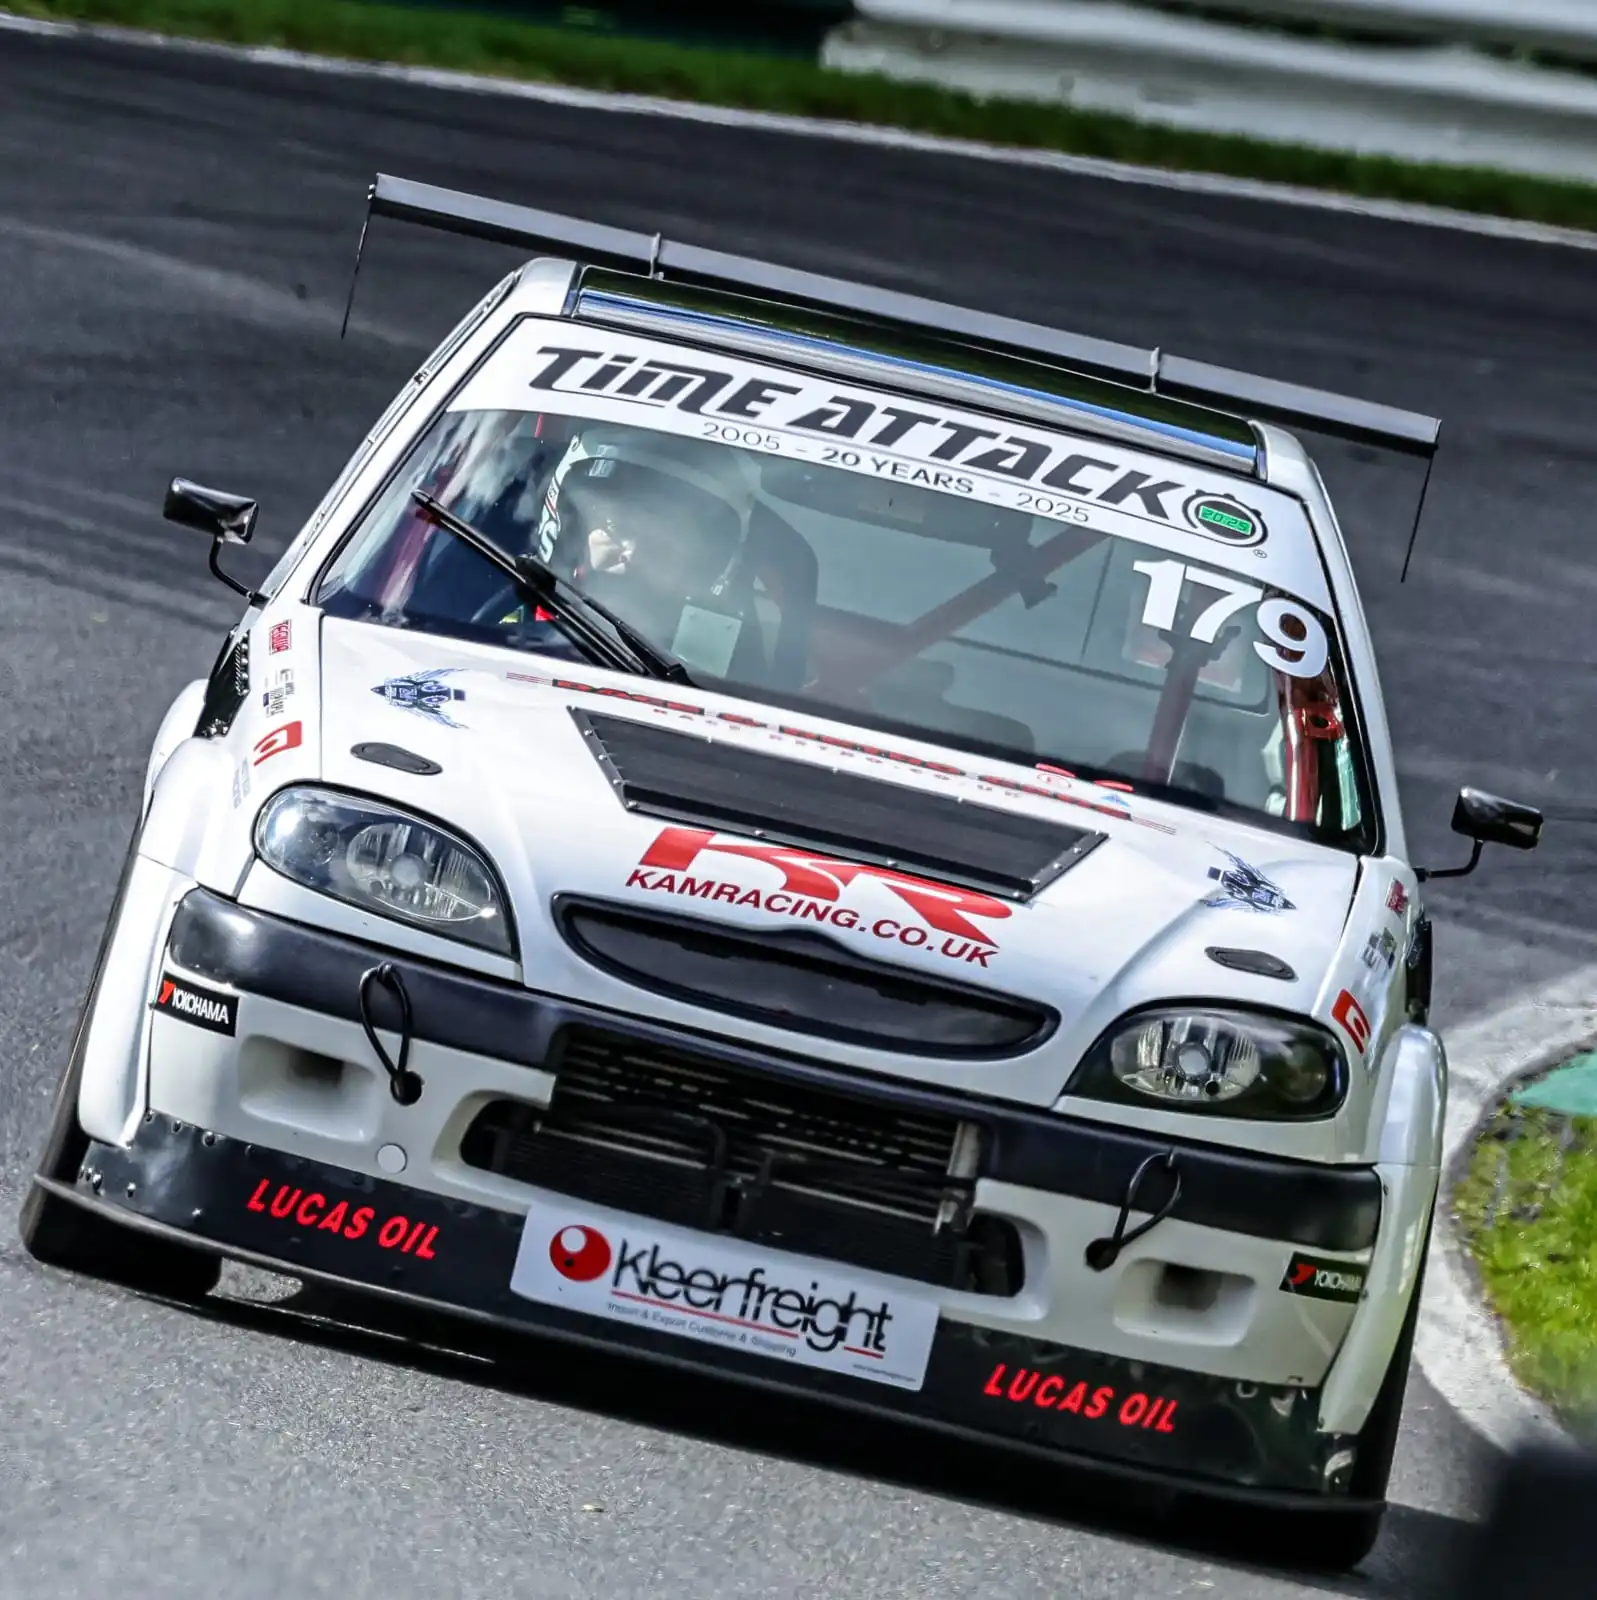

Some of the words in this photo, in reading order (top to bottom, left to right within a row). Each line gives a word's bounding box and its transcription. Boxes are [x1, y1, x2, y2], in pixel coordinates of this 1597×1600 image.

[703, 421, 780, 451] 2005
[822, 447, 861, 467] 20
[870, 458, 974, 495] YEARS
[1016, 492, 1090, 523] 2025
[787, 395, 1183, 520] ATTACK
[1132, 558, 1329, 679] 179
[625, 868, 1000, 969] KAMRACING.CO.UK
[171, 987, 230, 1025] YOKOHAMA
[247, 1178, 375, 1239] LUCAS
[378, 1215, 440, 1259] OIL
[983, 1363, 1114, 1419] LUCAS
[1118, 1392, 1178, 1433] OIL
